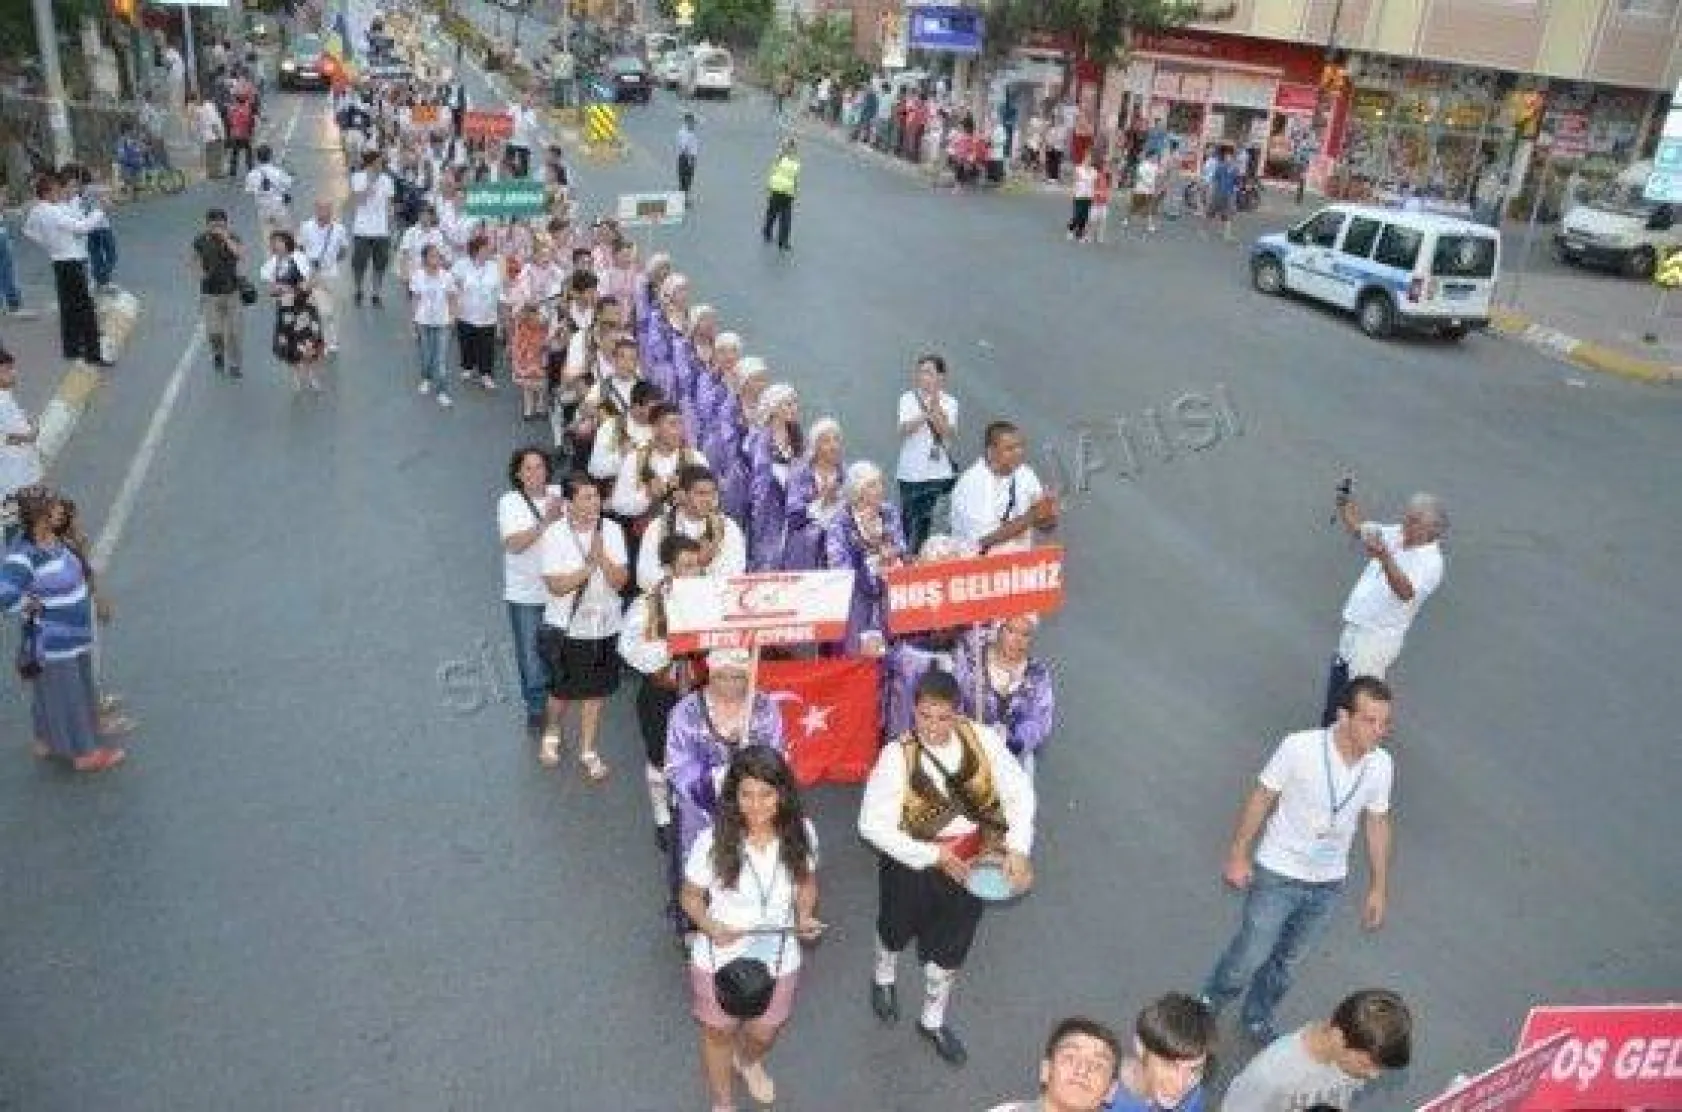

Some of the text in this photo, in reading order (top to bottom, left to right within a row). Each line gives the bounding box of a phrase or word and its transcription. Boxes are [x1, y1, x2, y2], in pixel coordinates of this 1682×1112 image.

[890, 560, 1062, 612] HOŞ GELDİNİZ
[1540, 1036, 1609, 1091] OŞ
